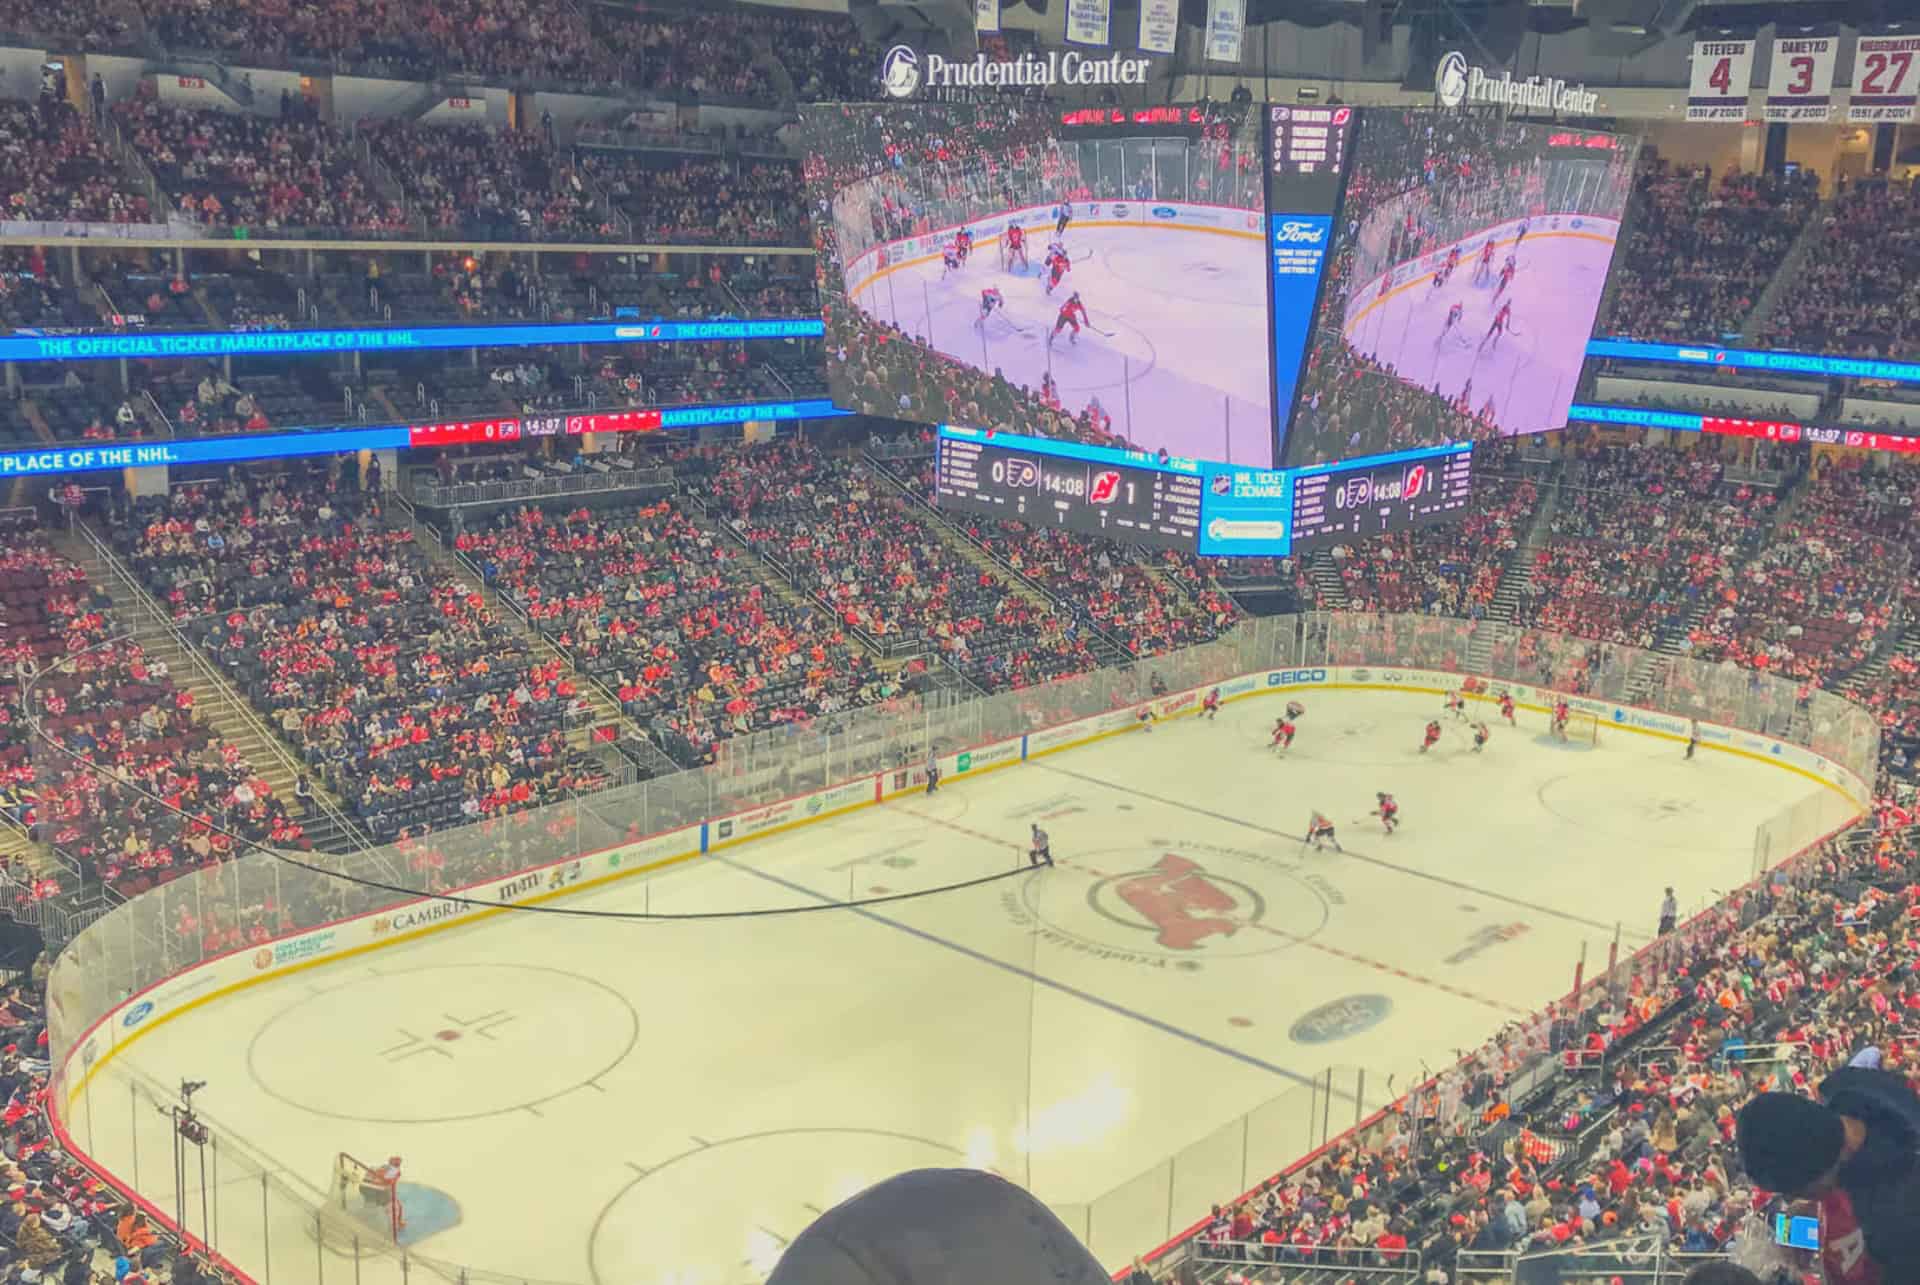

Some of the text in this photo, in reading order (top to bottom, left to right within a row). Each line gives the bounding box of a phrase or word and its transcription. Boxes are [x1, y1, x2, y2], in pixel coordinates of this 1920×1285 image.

[1702, 43, 1746, 56] STEVENS
[926, 51, 1149, 86] Prudential Center
[1709, 57, 1731, 95] 4
[1787, 56, 1815, 94] 3
[1861, 53, 1913, 94] 27
[1468, 66, 1599, 113] Prudential Center
[1277, 222, 1324, 243] Ford
[39, 340, 72, 355] THE
[77, 337, 158, 353] OFFICIAL
[160, 336, 217, 352] TICKET
[221, 333, 330, 350] MARKETPLACE
[334, 333, 354, 346] OF
[358, 332, 384, 346] THE
[485, 424, 494, 437] 0
[525, 418, 561, 432] 14:07
[589, 418, 596, 430] 1
[1767, 425, 1776, 436] 0
[1806, 428, 1840, 440] 14:07
[1868, 436, 1876, 447] 1
[69, 453, 94, 468] OF
[99, 450, 132, 465] THE
[137, 447, 178, 462] NHL.
[992, 461, 1004, 482] 0
[1427, 472, 1433, 492] 1
[1043, 473, 1085, 496] 14:08
[1126, 482, 1135, 505] 1
[1375, 482, 1401, 501] 14:08
[1336, 486, 1345, 509] 0
[1268, 670, 1326, 686] GEICO
[393, 900, 471, 930] CAMBRIA
